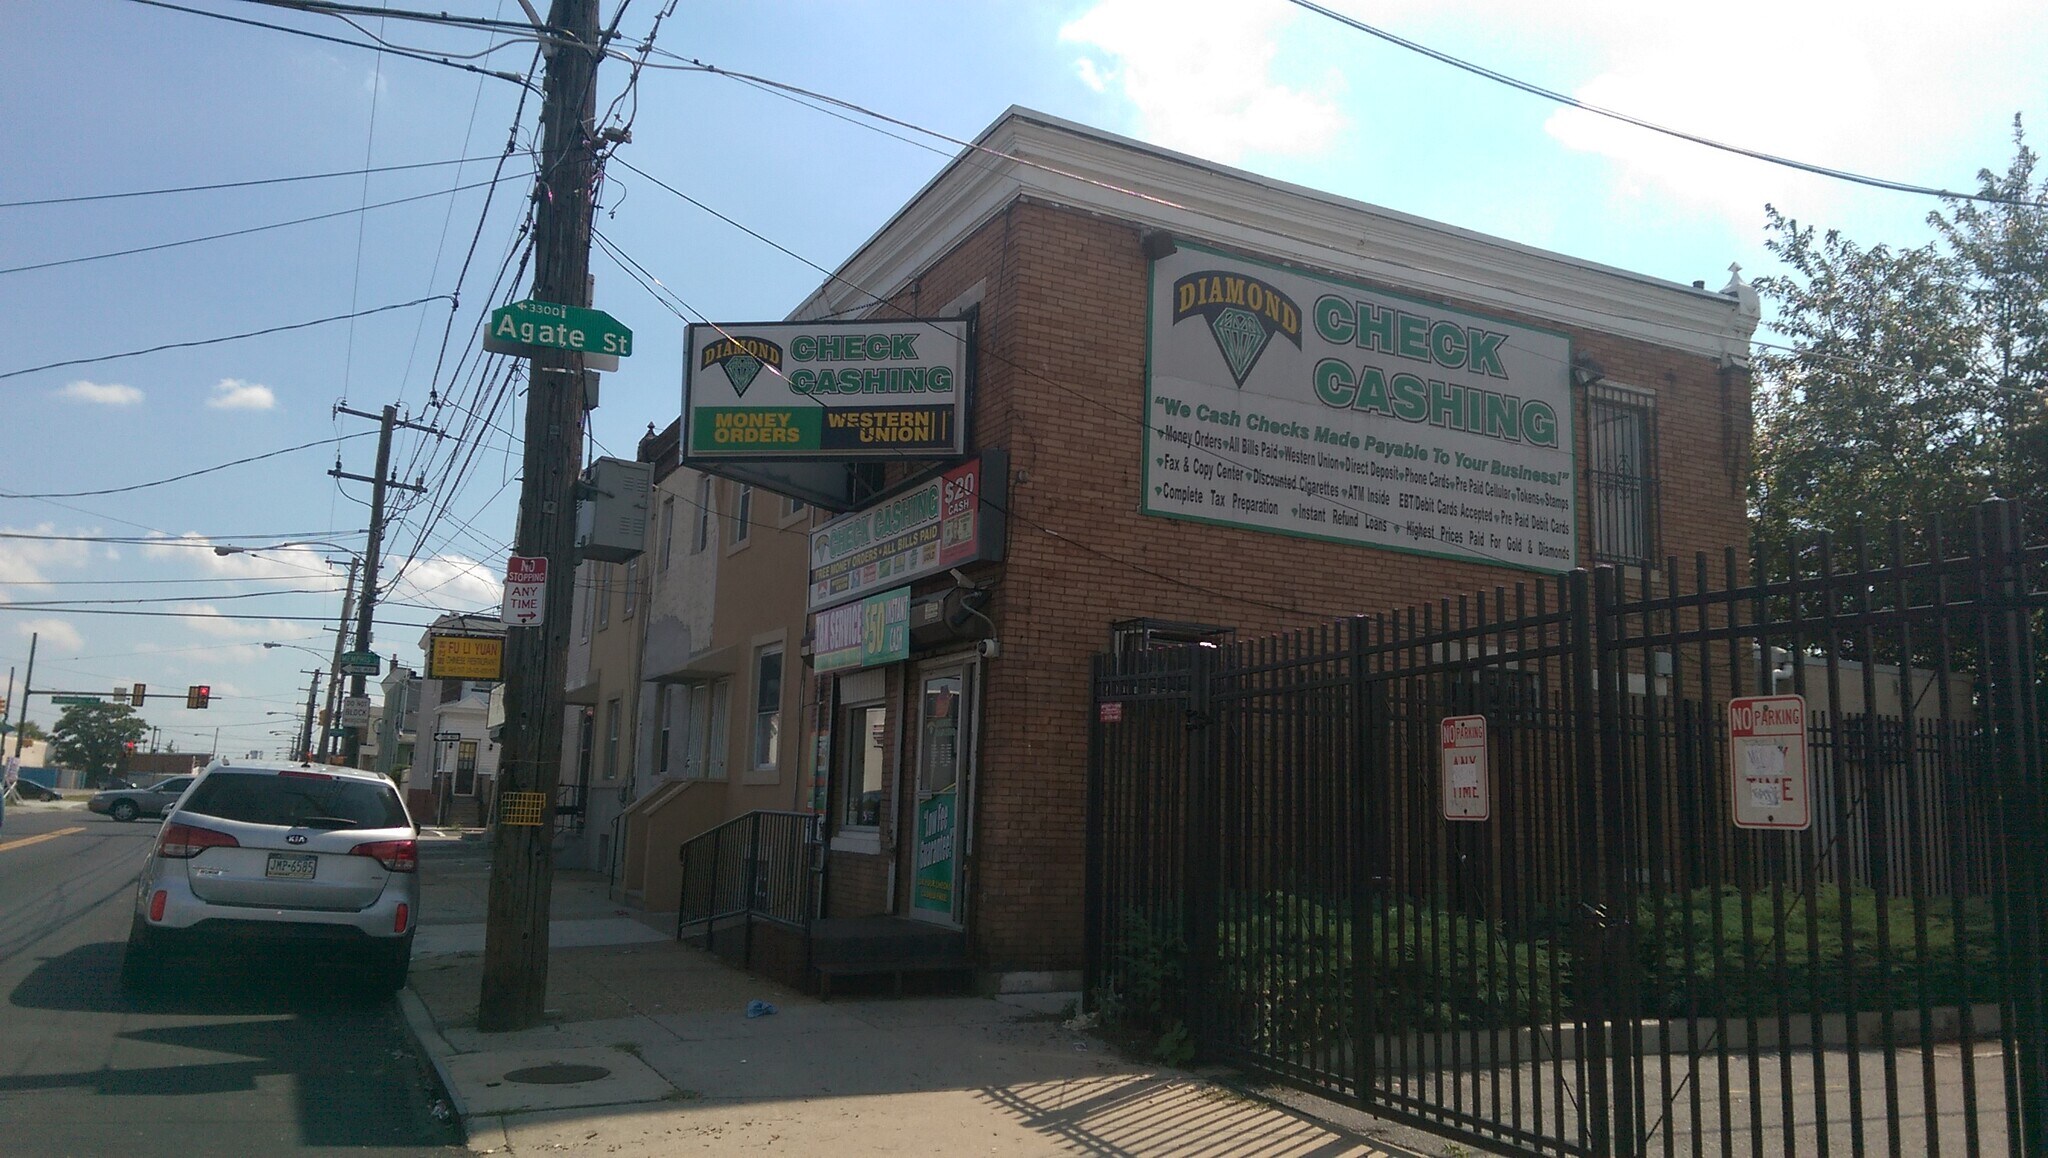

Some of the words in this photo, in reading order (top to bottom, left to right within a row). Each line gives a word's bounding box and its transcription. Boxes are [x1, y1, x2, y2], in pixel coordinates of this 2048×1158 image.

[529, 303, 560, 316] 3300
[1178, 276, 1298, 335] DIAMOND
[496, 314, 585, 347] Agate
[603, 332, 628, 354] St
[790, 333, 920, 362] CHECK
[1312, 293, 1509, 380] CHECK
[704, 341, 781, 366] DIAMOND
[789, 366, 953, 395] CASHING
[1312, 357, 1559, 449] CASHING
[715, 413, 792, 428] MONEY
[828, 411, 929, 428] WESTERN
[714, 427, 800, 443] ORDERS
[859, 427, 929, 442] UNION
[1196, 404, 1241, 427] Cash
[1246, 413, 1310, 440] Checks
[1313, 425, 1360, 449] Made
[1364, 435, 1428, 461] Payable
[1433, 447, 1450, 466] To
[1454, 451, 1489, 473] Your
[1165, 425, 1192, 449] Money
[1194, 430, 1222, 451] Orders
[1228, 436, 1240, 453] All
[1242, 438, 1259, 457] Bills
[1261, 442, 1279, 460] Paid
[1284, 445, 1316, 467] Western
[1317, 452, 1339, 470] Union
[1345, 456, 1369, 477] Direct
[1370, 461, 1400, 482] Deposit
[1404, 467, 1428, 486] Phone
[1428, 471, 1451, 489] Cards
[1455, 476, 1468, 492] Pre
[1468, 478, 1485, 495] Paid
[1485, 481, 1512, 500] Cellular
[1516, 487, 1540, 506] Tokens
[1544, 492, 1569, 513] Stamps
[945, 473, 974, 505] $20
[1164, 453, 1180, 472] Fax
[1183, 457, 1190, 473] &
[1193, 458, 1213, 481] Copy
[1216, 462, 1244, 482] Center
[1253, 468, 1297, 490] Discounted
[1300, 476, 1340, 498] Cigarettes
[1348, 484, 1364, 501] ATM
[1367, 487, 1390, 506] Inside
[1436, 499, 1458, 517] Cards
[1459, 503, 1493, 524] Accepted
[1500, 509, 1513, 526] Pre
[1514, 512, 1530, 529] Paid
[1531, 514, 1549, 532] Debit
[1550, 518, 1570, 536] Cards
[948, 499, 970, 516] CASH
[829, 513, 873, 559] CHECK
[873, 484, 940, 541] CASHING
[1163, 482, 1203, 506] Complete
[1210, 489, 1226, 508] Tax
[1232, 492, 1279, 516] Preparation
[1298, 503, 1326, 523] Instant
[1332, 509, 1359, 528] Refund
[1365, 513, 1388, 533] Loans
[1406, 520, 1435, 541] Highest
[1440, 525, 1463, 544] Prices
[1469, 530, 1485, 547] Paid
[1490, 533, 1501, 549] For
[1506, 537, 1522, 553] Gold
[1527, 539, 1533, 554] &
[1538, 541, 1570, 561] Diamonds
[521, 560, 536, 573] NO
[815, 565, 831, 581] FREE
[830, 559, 850, 576] MONEY
[852, 547, 879, 567] ORDERS
[882, 542, 897, 557] ALL
[897, 532, 919, 551] BILLS
[919, 525, 938, 542] PAID
[508, 571, 545, 582] STOPPING
[511, 586, 538, 596] ANY
[511, 598, 538, 609] TIME
[816, 615, 830, 653] TAX
[829, 604, 862, 649] SERVICE
[864, 601, 885, 654] $50
[448, 641, 460, 654] FU
[463, 641, 471, 655] LI
[474, 641, 498, 656] YUAN
[1731, 708, 1752, 731] NO
[1754, 708, 1800, 726] PARKING
[1443, 725, 1455, 744] NO
[1456, 726, 1483, 740] PARKING
[287, 835, 305, 843] KIA
